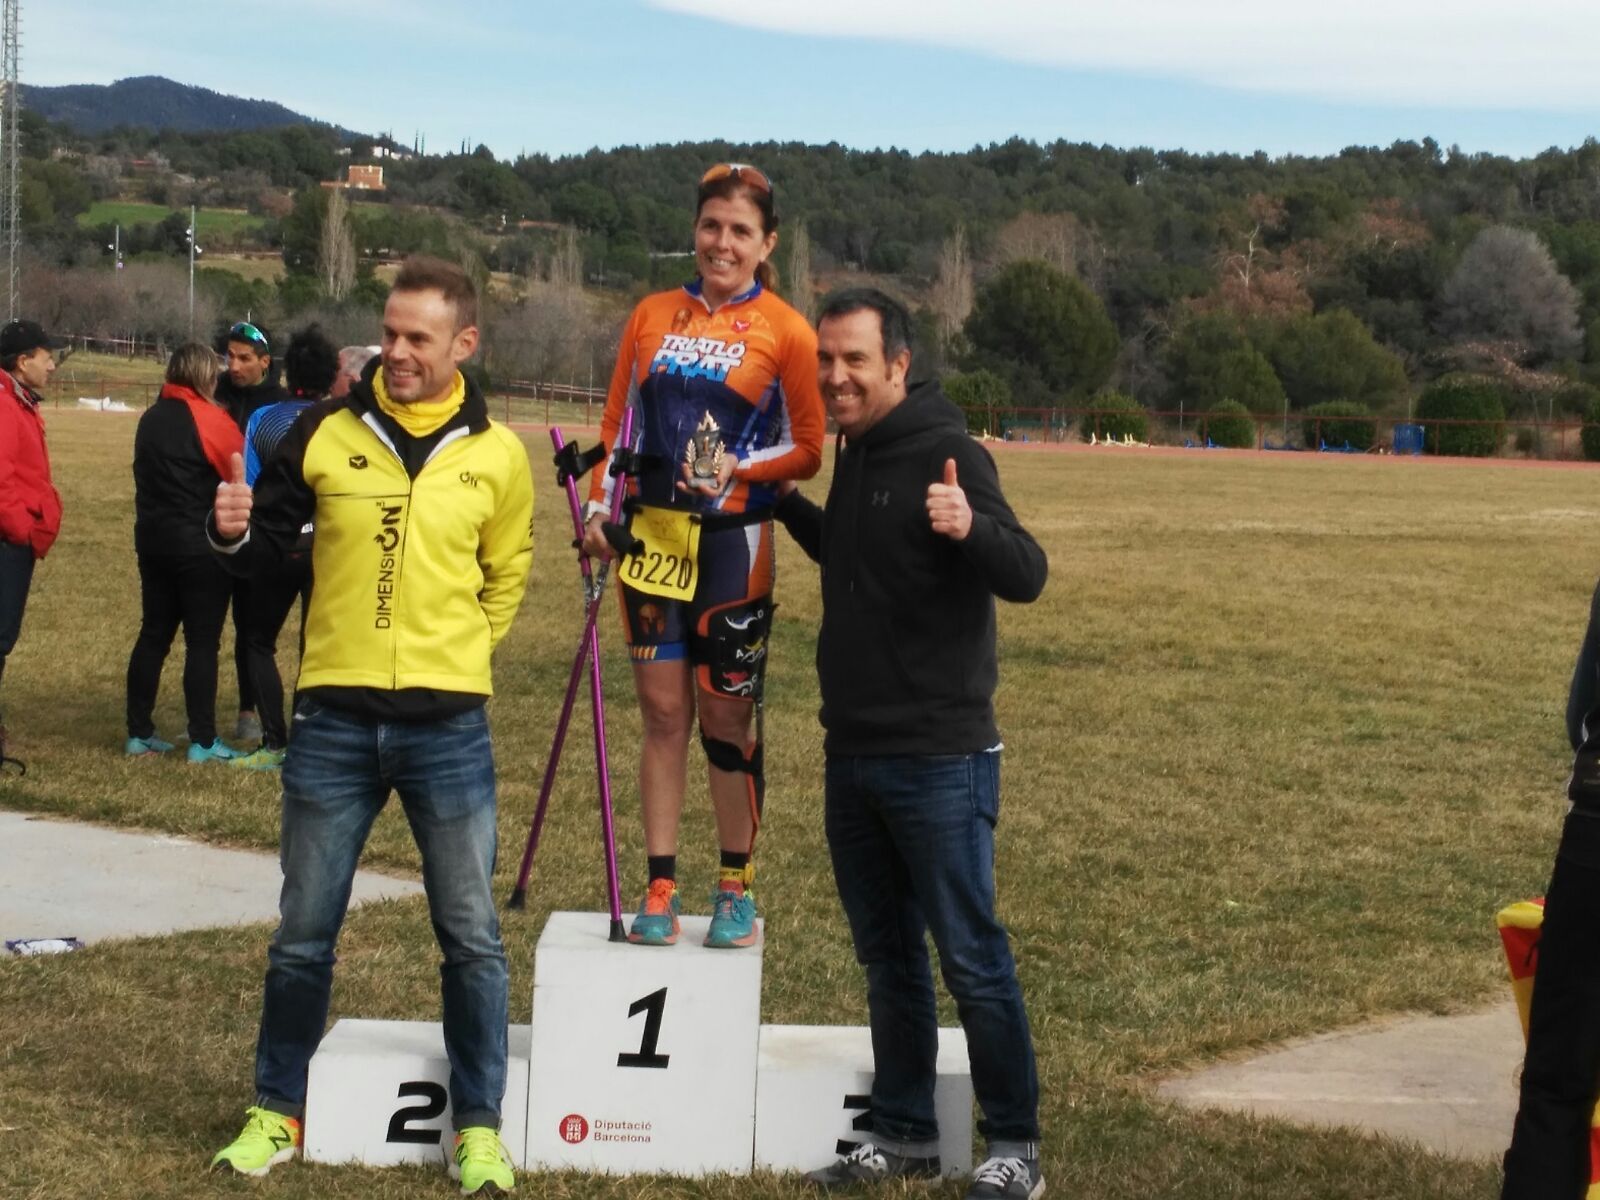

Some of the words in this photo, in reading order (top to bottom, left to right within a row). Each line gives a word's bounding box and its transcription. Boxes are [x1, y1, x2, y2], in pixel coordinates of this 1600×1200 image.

[663, 334, 746, 359] TRIATLÓ
[650, 349, 742, 383] PRAT
[628, 552, 693, 590] 6220
[616, 987, 671, 1069] 1
[386, 1081, 449, 1145] 2
[594, 1119, 652, 1131] Diputació
[594, 1131, 651, 1143] Barcelona
